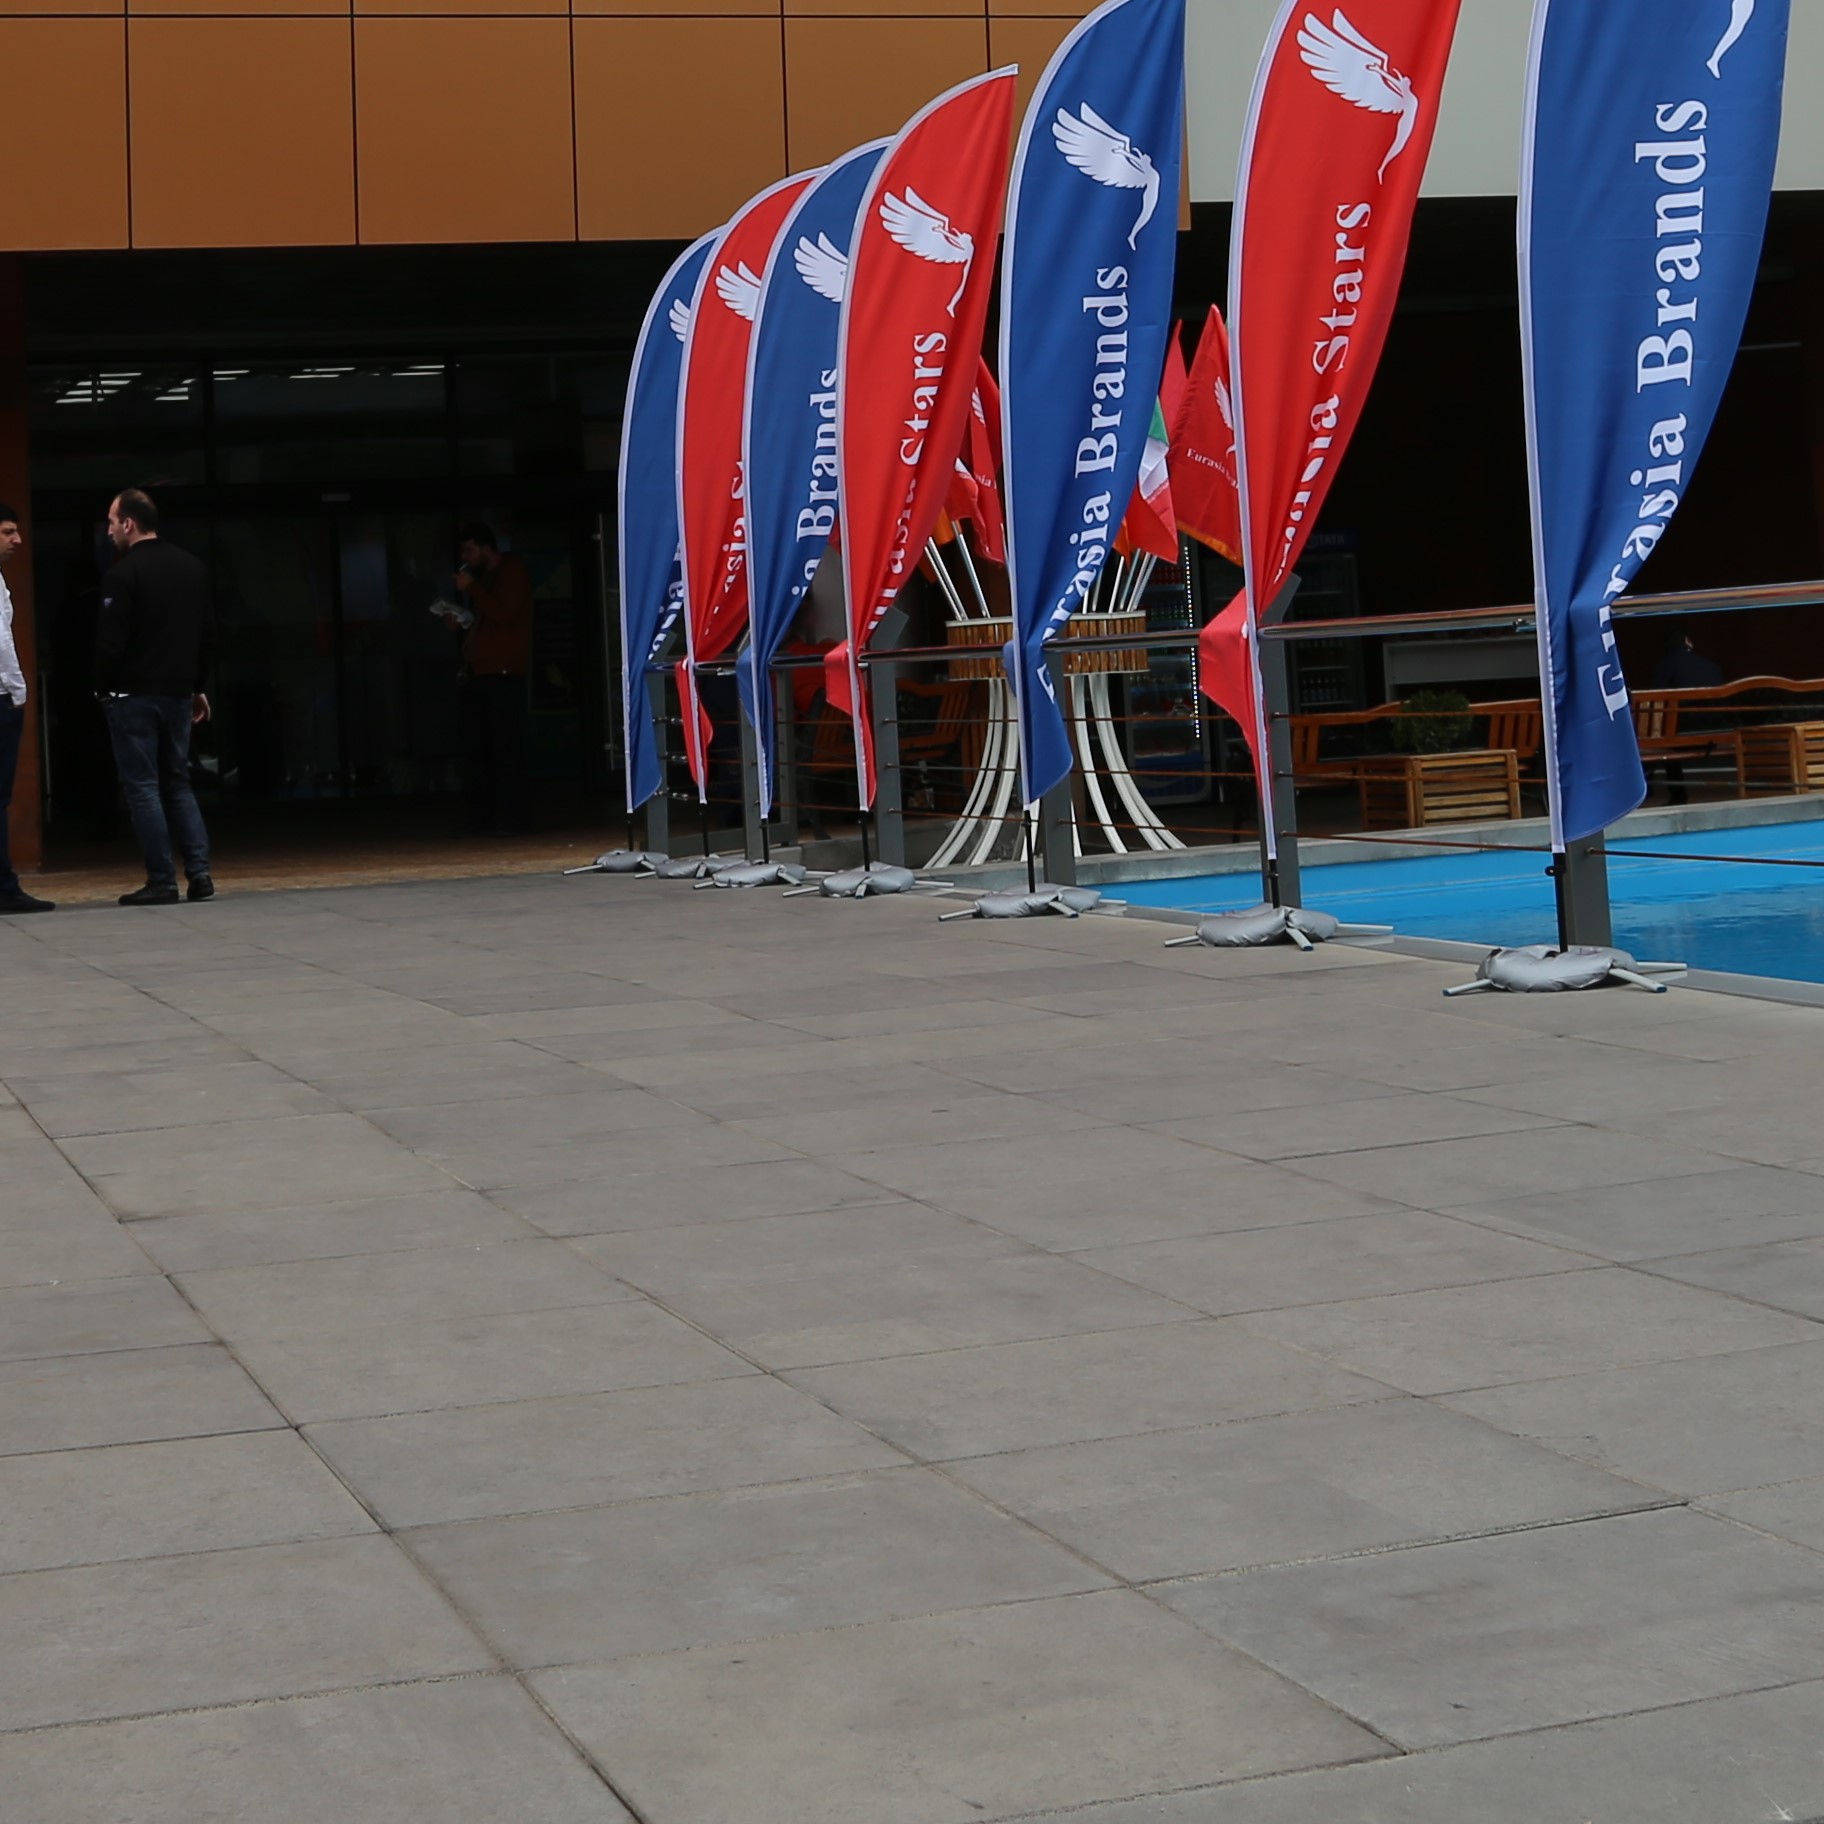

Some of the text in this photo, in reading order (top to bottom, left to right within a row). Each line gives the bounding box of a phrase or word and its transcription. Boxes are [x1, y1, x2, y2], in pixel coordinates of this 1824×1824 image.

[1313, 204, 1370, 373] Stars
[1636, 101, 1707, 393] Brands
[797, 368, 837, 541] Brands
[1037, 267, 1128, 704] rasia Brands
